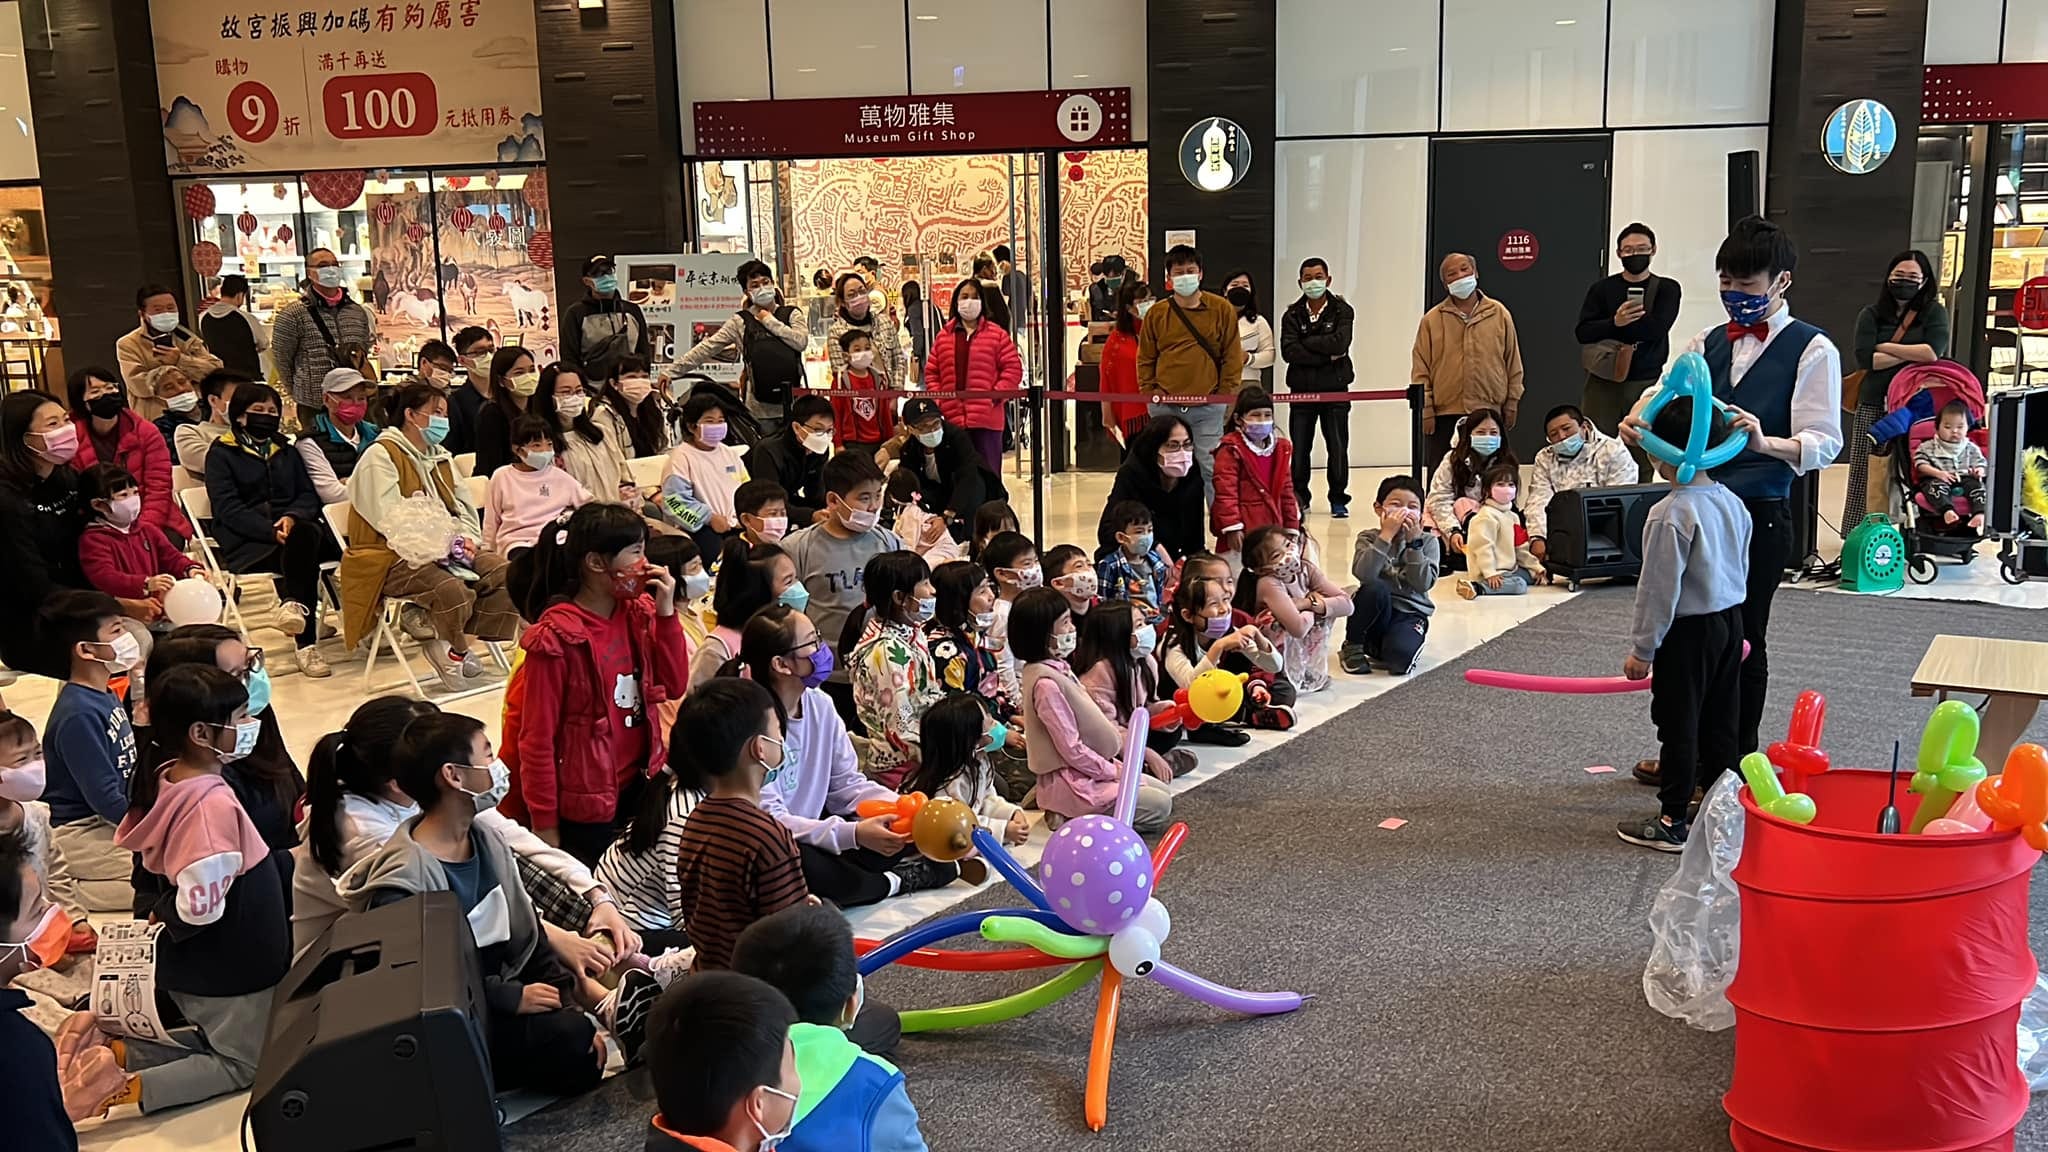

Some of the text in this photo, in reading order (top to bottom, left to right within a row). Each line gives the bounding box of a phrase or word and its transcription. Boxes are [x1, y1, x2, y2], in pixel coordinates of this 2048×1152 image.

[220, 0, 481, 40] 故宮振興加碼有夠厲害
[215, 58, 248, 76] 購物
[318, 50, 388, 71] 滿千再送
[241, 95, 300, 137] 9 折
[341, 87, 416, 131] 100
[859, 102, 955, 128] 萬物雅集
[844, 129, 976, 143] Museum Gift Shop
[1508, 235, 1530, 245] 1116
